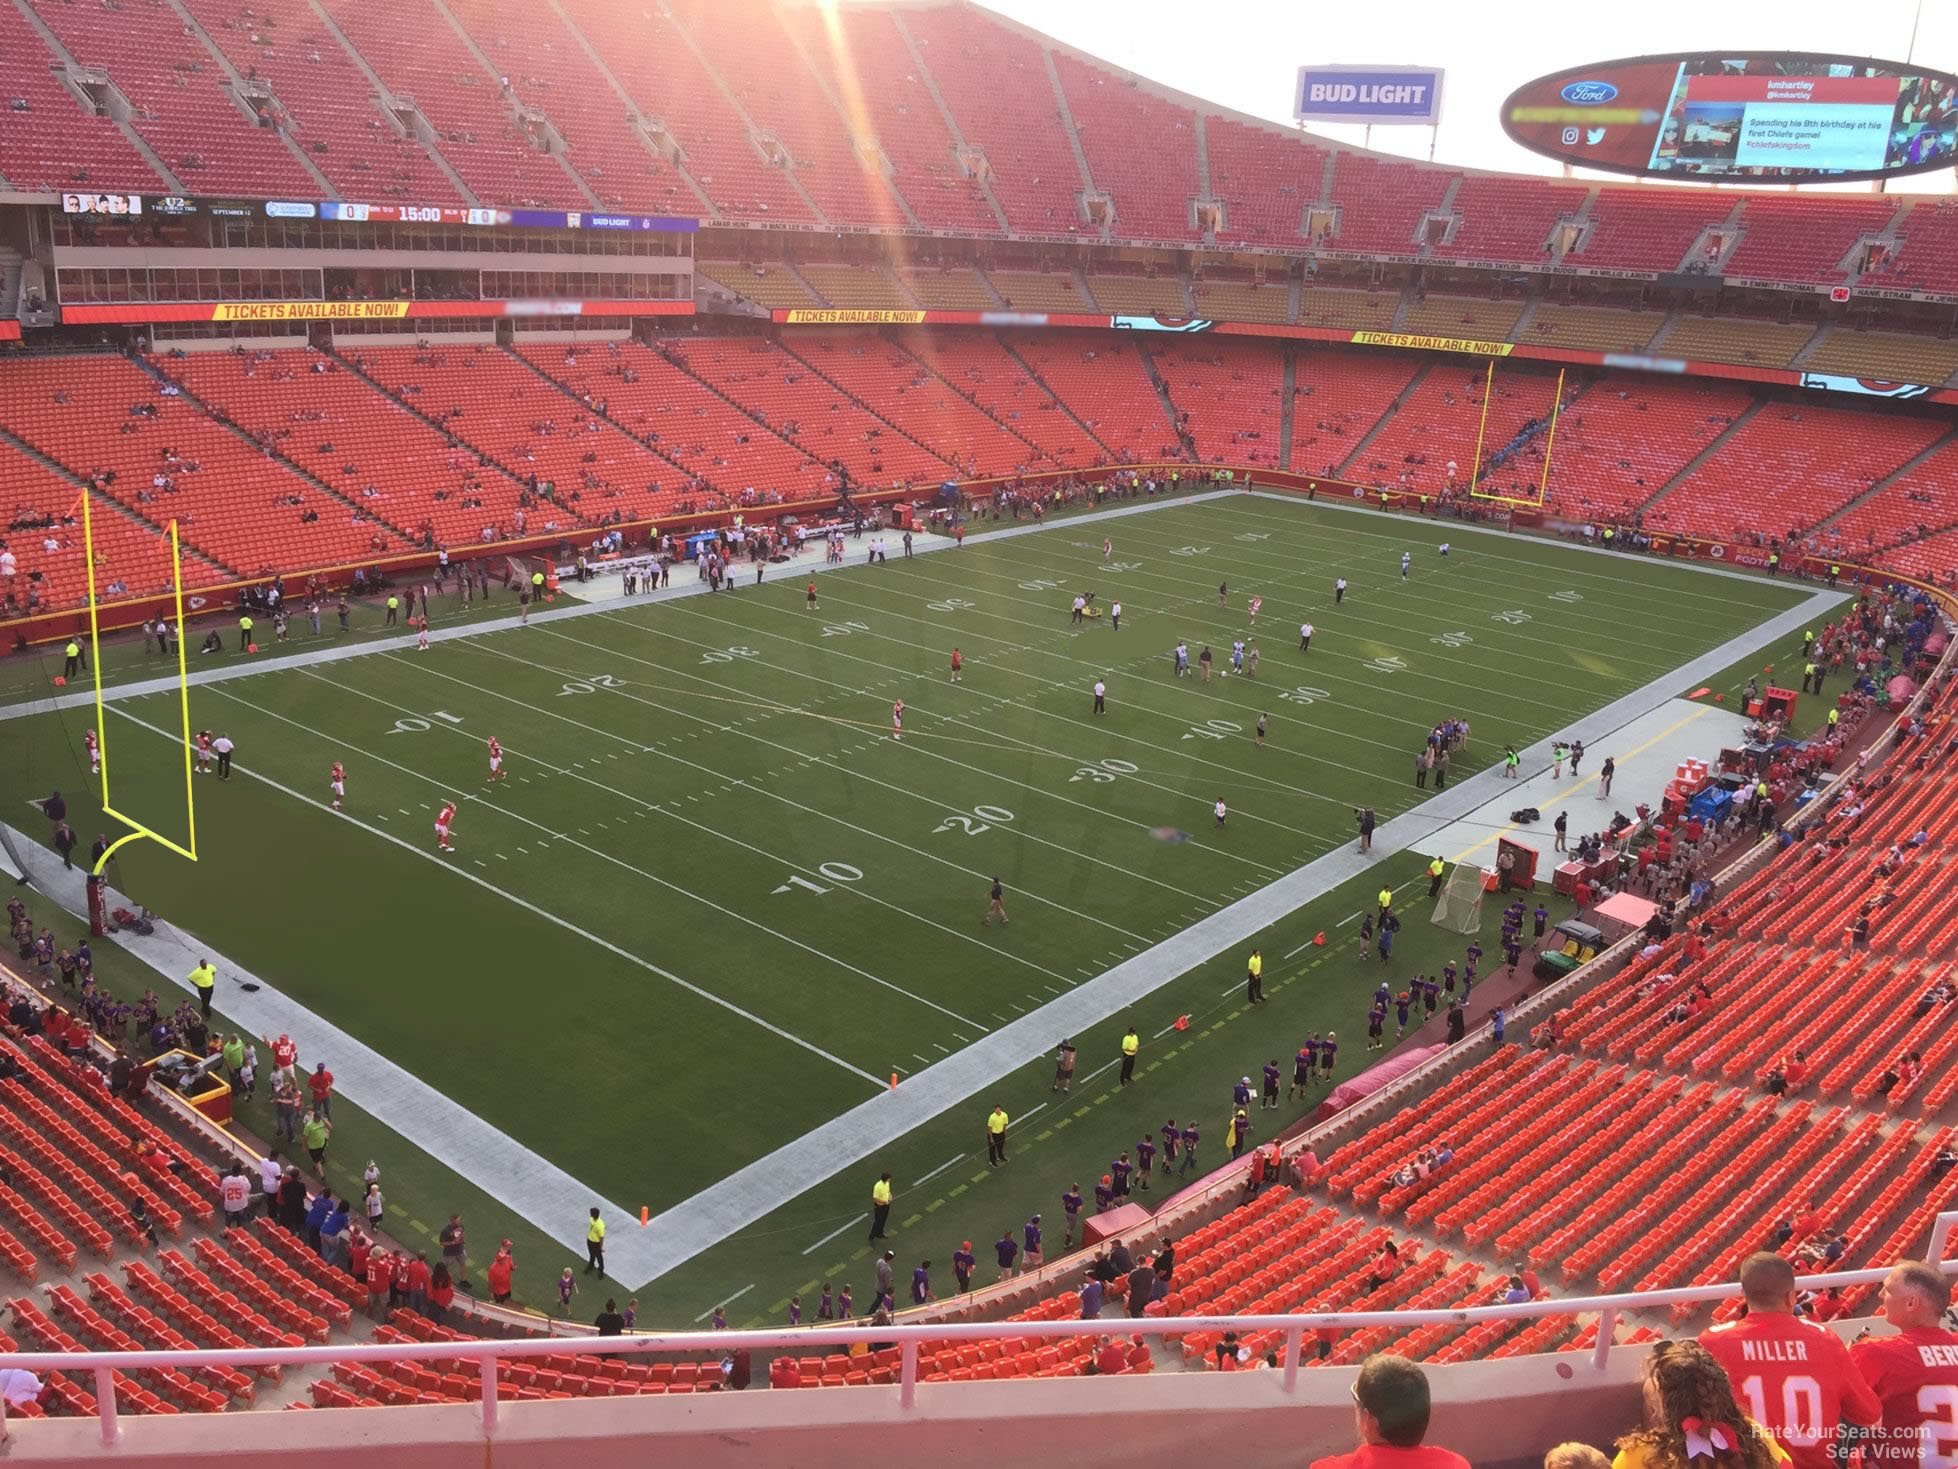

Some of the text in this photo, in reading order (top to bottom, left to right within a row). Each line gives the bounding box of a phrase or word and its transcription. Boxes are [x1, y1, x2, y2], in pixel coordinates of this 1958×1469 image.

[1571, 85, 1606, 100] Ford
[1768, 80, 1814, 91] kmhartley
[1311, 84, 1426, 104] BUD LIGHT
[1767, 92, 1812, 100] @kmhartley
[1750, 119, 1788, 129] Spending
[1790, 119, 1802, 128] his
[1820, 120, 1856, 130] birthday
[1868, 120, 1882, 129] his
[1748, 129, 1821, 140] first Chiefs game!
[1746, 140, 1810, 150] #chiefskingdom
[165, 197, 184, 207] U2
[347, 206, 354, 218] 0
[399, 206, 440, 221] 15:00
[481, 211, 489, 223] 0
[609, 218, 630, 227] LIGHT
[1783, 284, 1816, 292] THOMAS
[1883, 290, 1912, 299] STRAM
[224, 304, 399, 318] TICKETS AVAILABLE NOW!
[795, 311, 918, 322] TICKETS AVAILABLE NOW!
[1361, 332, 1504, 354] TICKETS AVAILABLE NOW!
[703, 646, 760, 662] 30
[562, 674, 627, 694] 20
[1278, 686, 1331, 705] 50
[395, 710, 464, 731] 10
[1190, 720, 1243, 739] 40
[1075, 758, 1139, 782] 30
[943, 805, 1015, 836] 20
[787, 862, 864, 896] 10
[96, 883, 108, 936] CHIEFS
[278, 1045, 290, 1056] 20
[227, 1188, 242, 1200] 25
[1742, 1341, 1808, 1361] MILLER
[1742, 1376, 1823, 1447] 10
